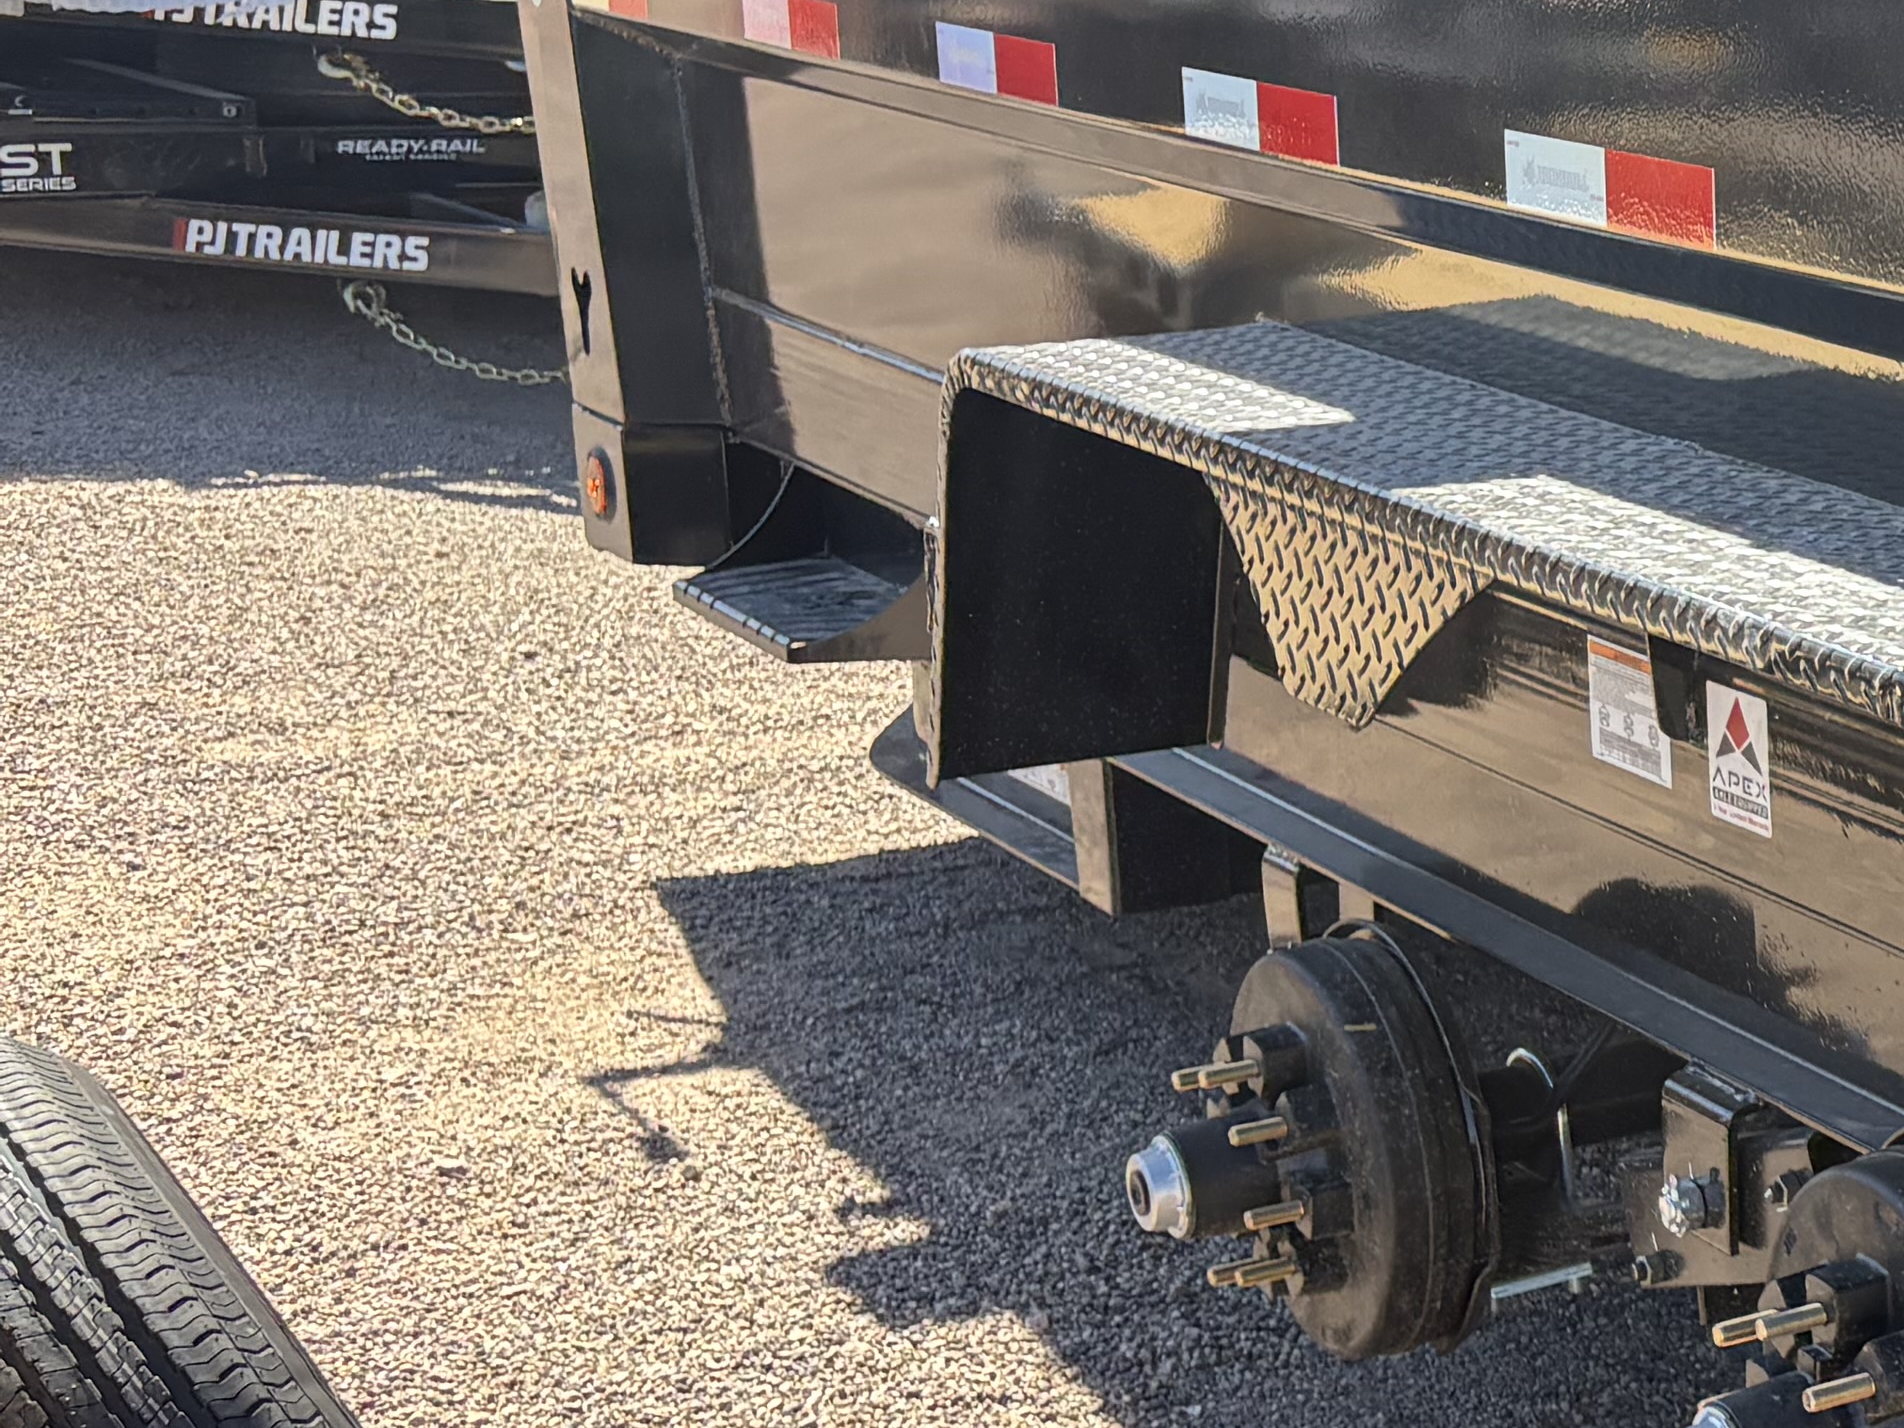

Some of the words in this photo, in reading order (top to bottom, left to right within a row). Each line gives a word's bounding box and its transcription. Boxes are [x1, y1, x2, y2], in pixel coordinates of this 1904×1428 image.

[1, 176, 77, 192] SERIES
[232, 222, 429, 271] TRAILERS
[1712, 765, 1768, 803] APEX
